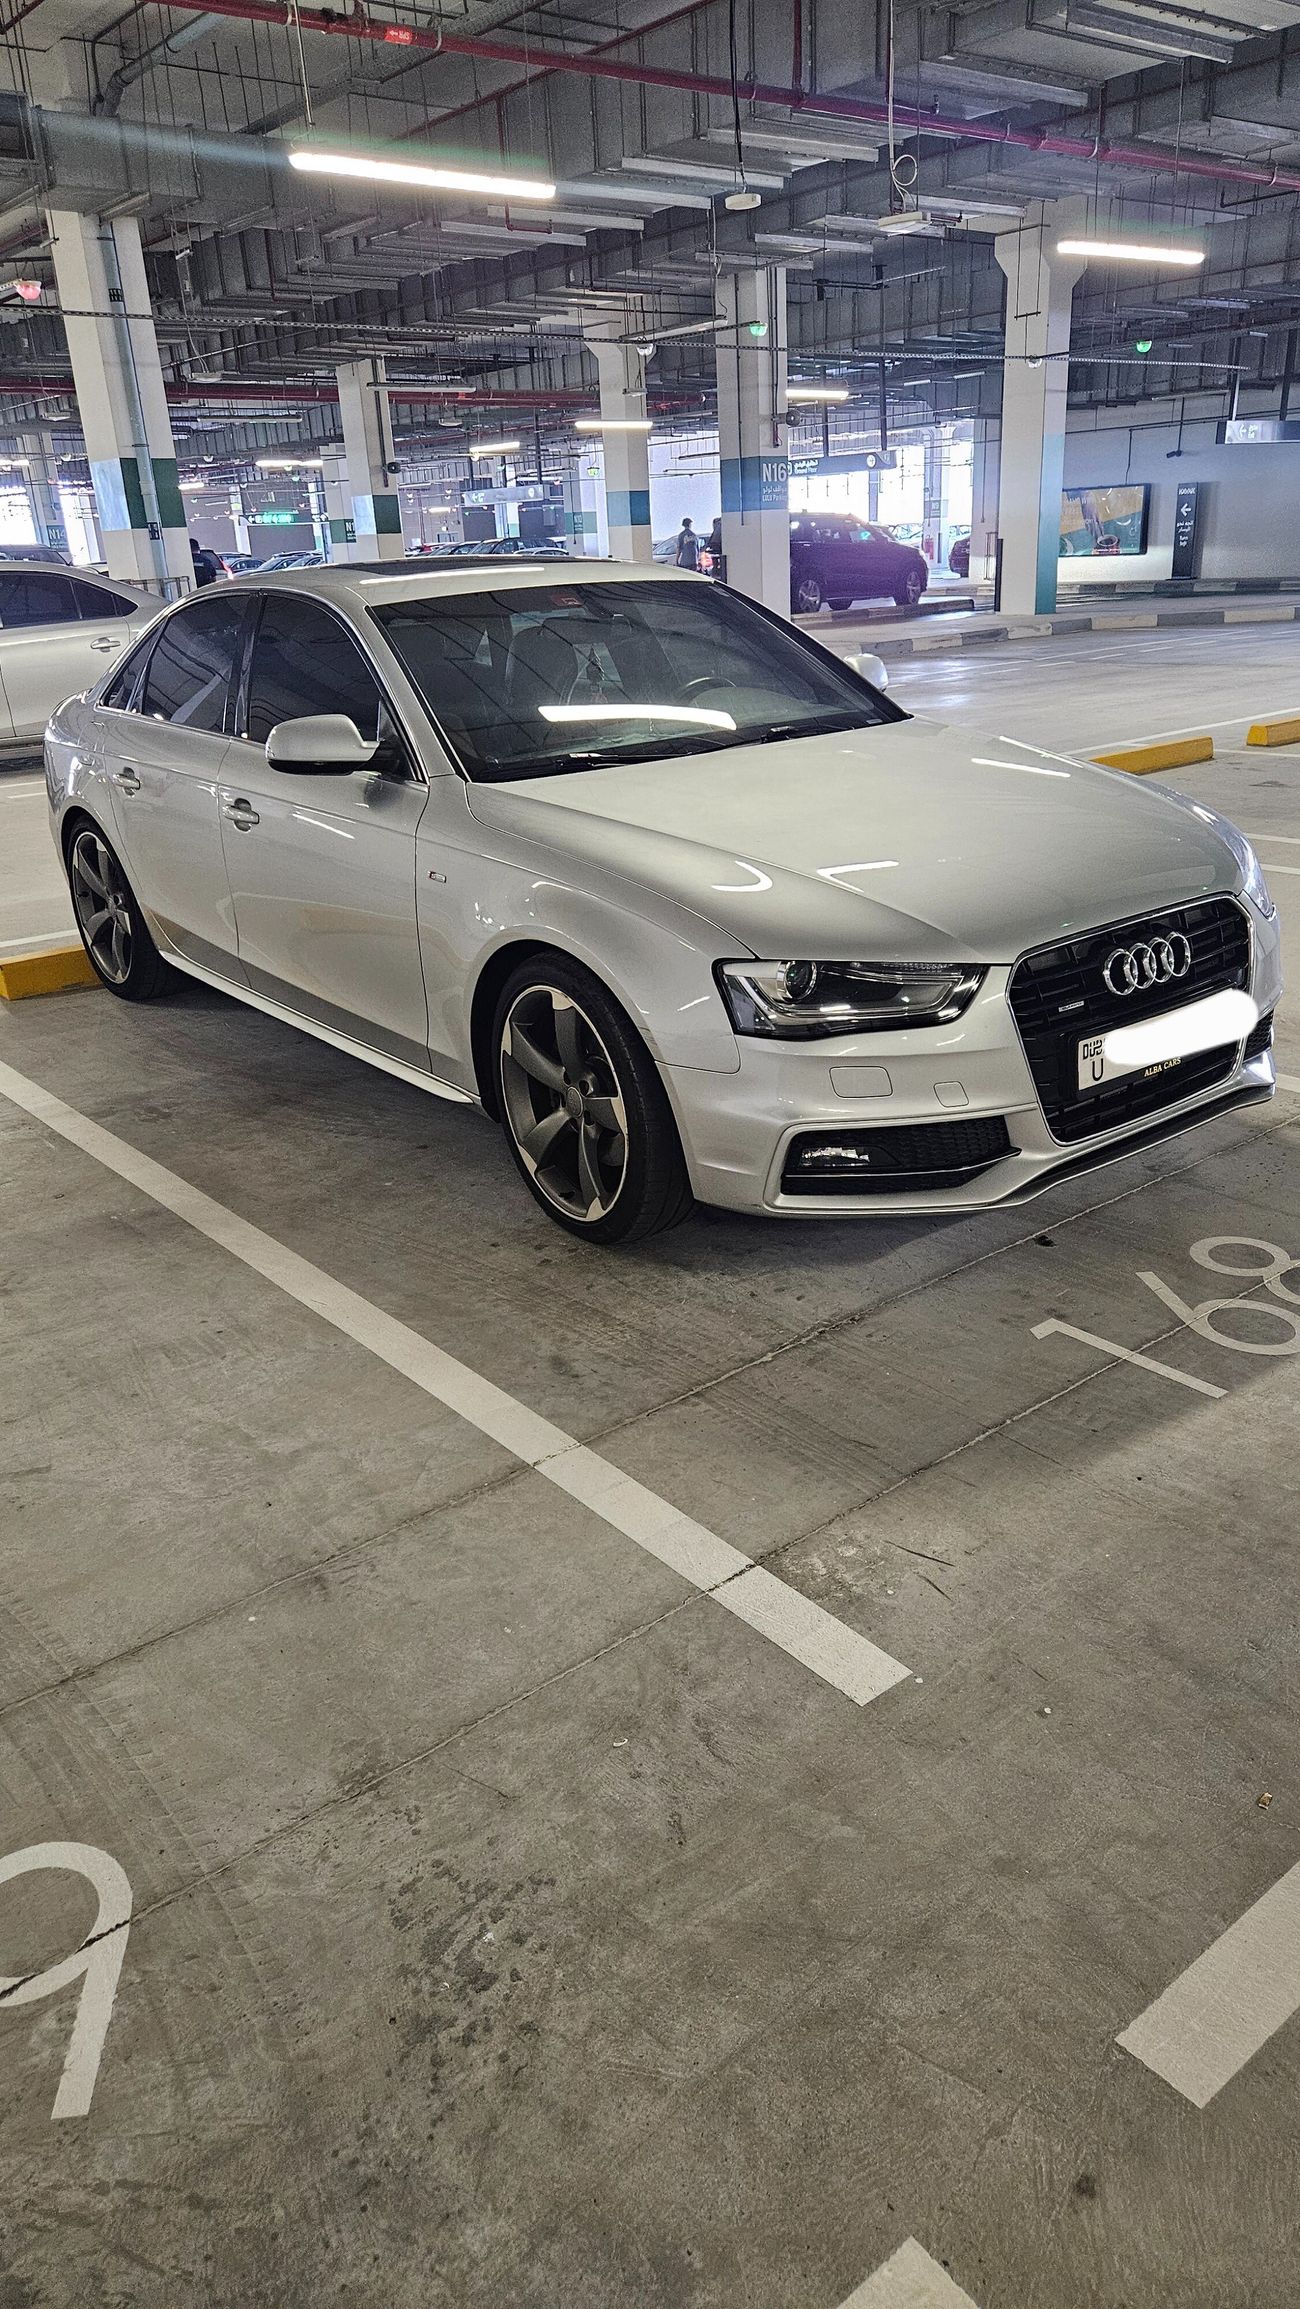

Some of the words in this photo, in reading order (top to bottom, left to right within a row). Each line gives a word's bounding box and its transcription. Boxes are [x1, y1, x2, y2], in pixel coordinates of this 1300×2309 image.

[763, 463, 787, 481] N16
[1083, 1038, 1106, 1060] DUB
[1092, 1058, 1103, 1081] U
[1144, 1064, 1162, 1077] ALBA
[1164, 1058, 1181, 1070] CARS
[1029, 1235, 1300, 1399] 168
[0, 1841, 133, 2120] 9
